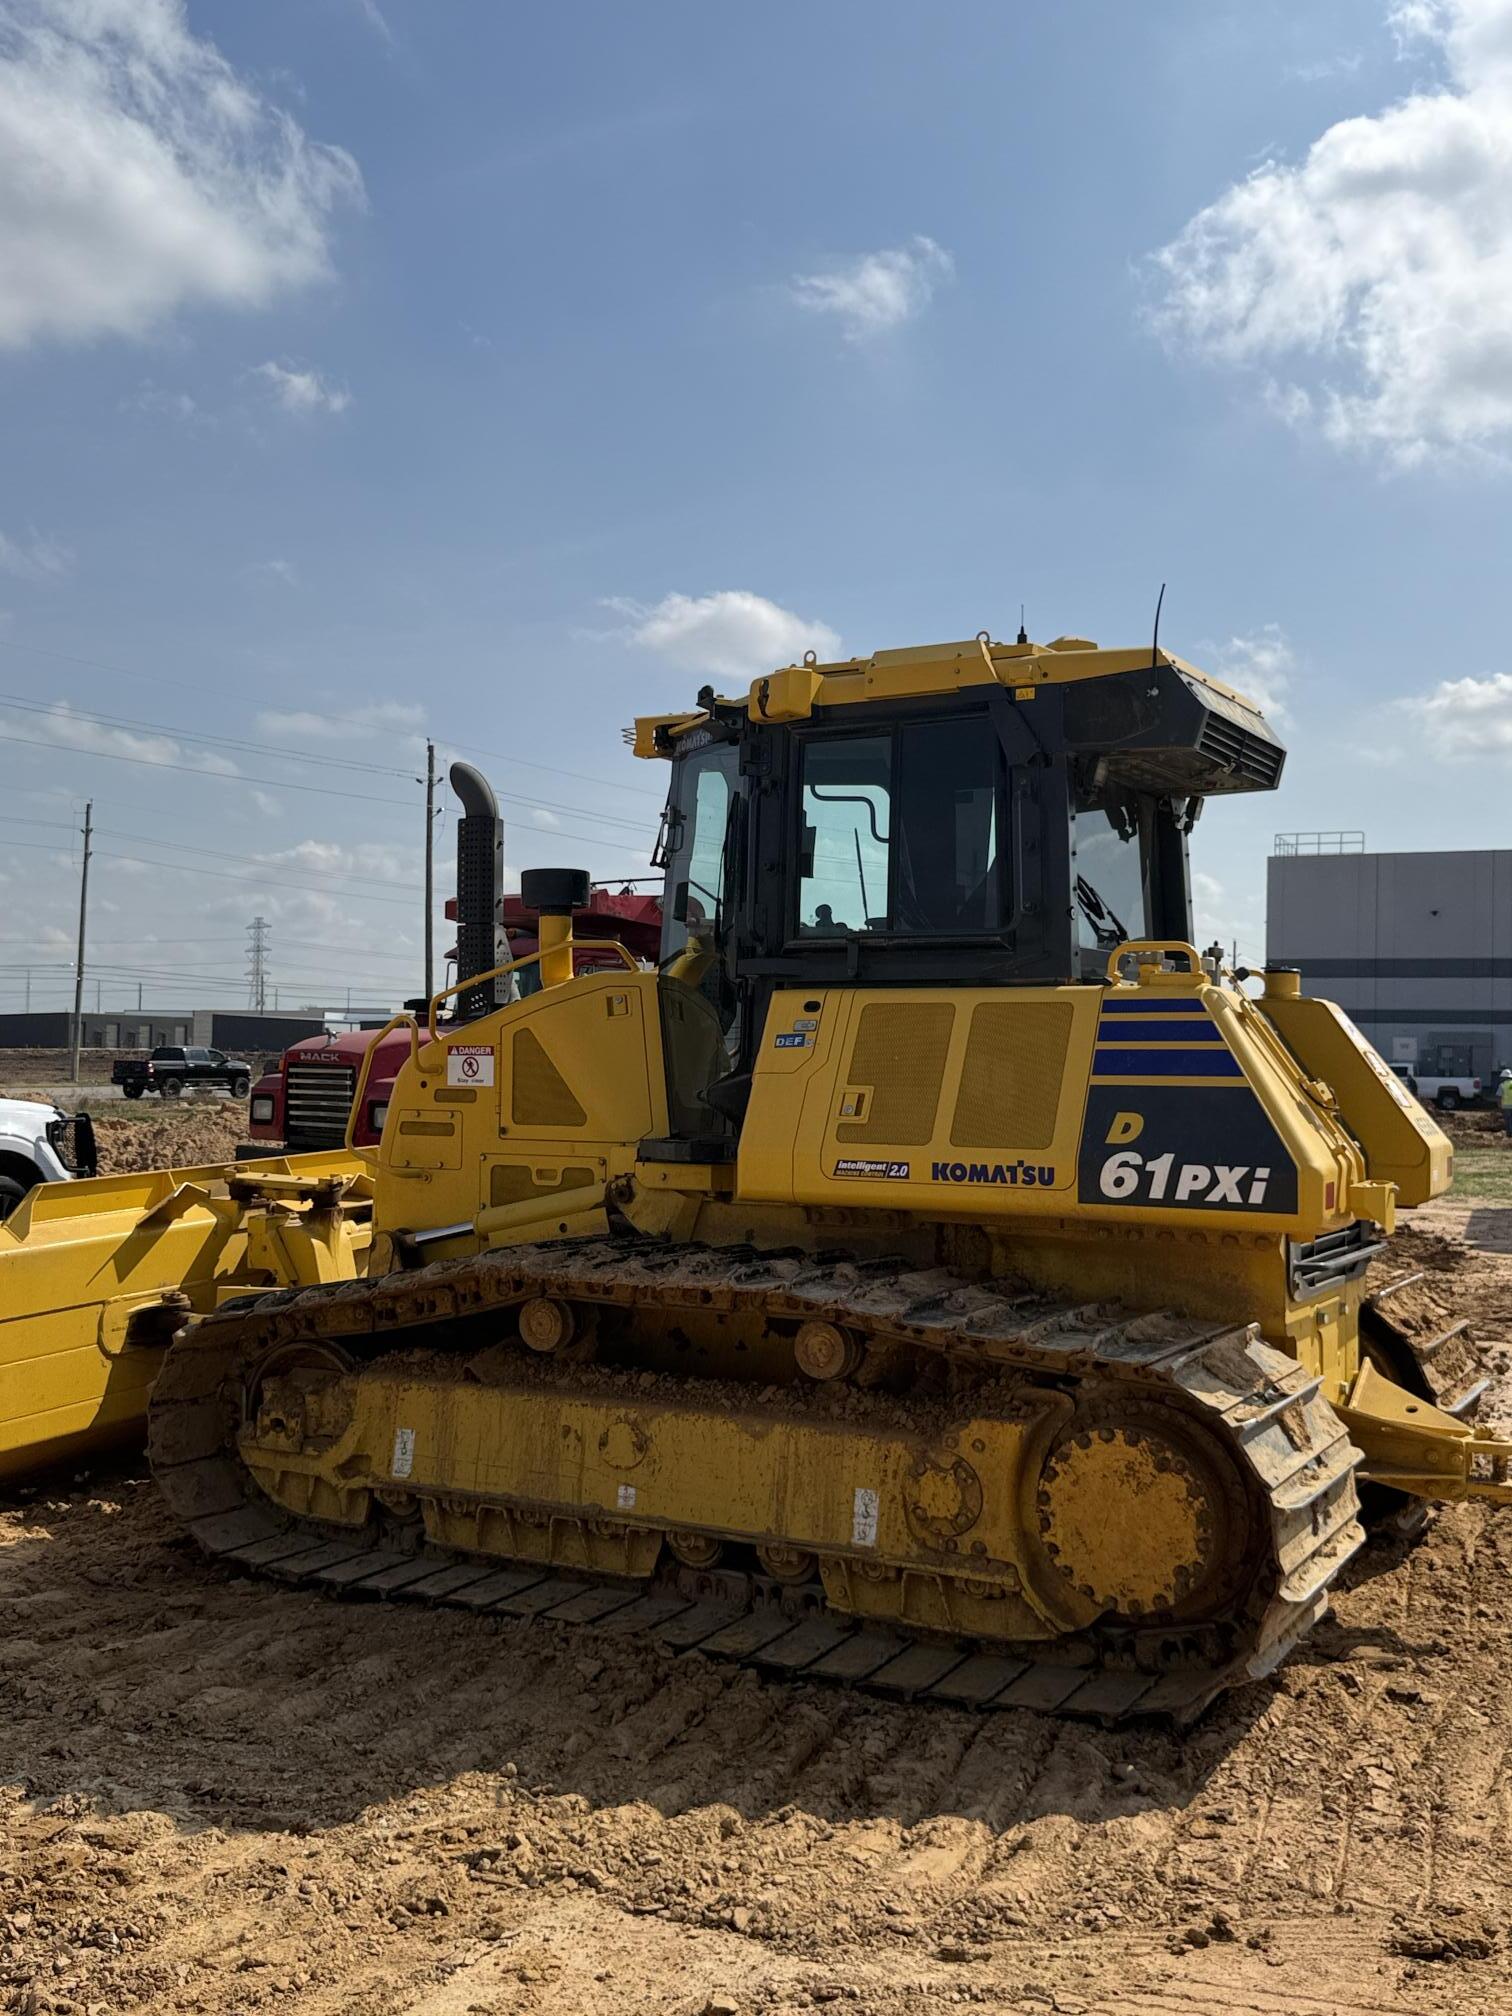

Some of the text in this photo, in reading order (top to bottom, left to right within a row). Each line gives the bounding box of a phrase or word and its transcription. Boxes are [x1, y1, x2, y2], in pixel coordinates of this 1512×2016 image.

[776, 1036, 803, 1046] DEF
[300, 1052, 341, 1061] MACK
[459, 1046, 492, 1055] DANGER
[1105, 1111, 1145, 1144] D
[889, 1164, 908, 1177] 2.0
[932, 1160, 1055, 1186] KOMATSU
[1099, 1151, 1271, 1205] 61PXi
